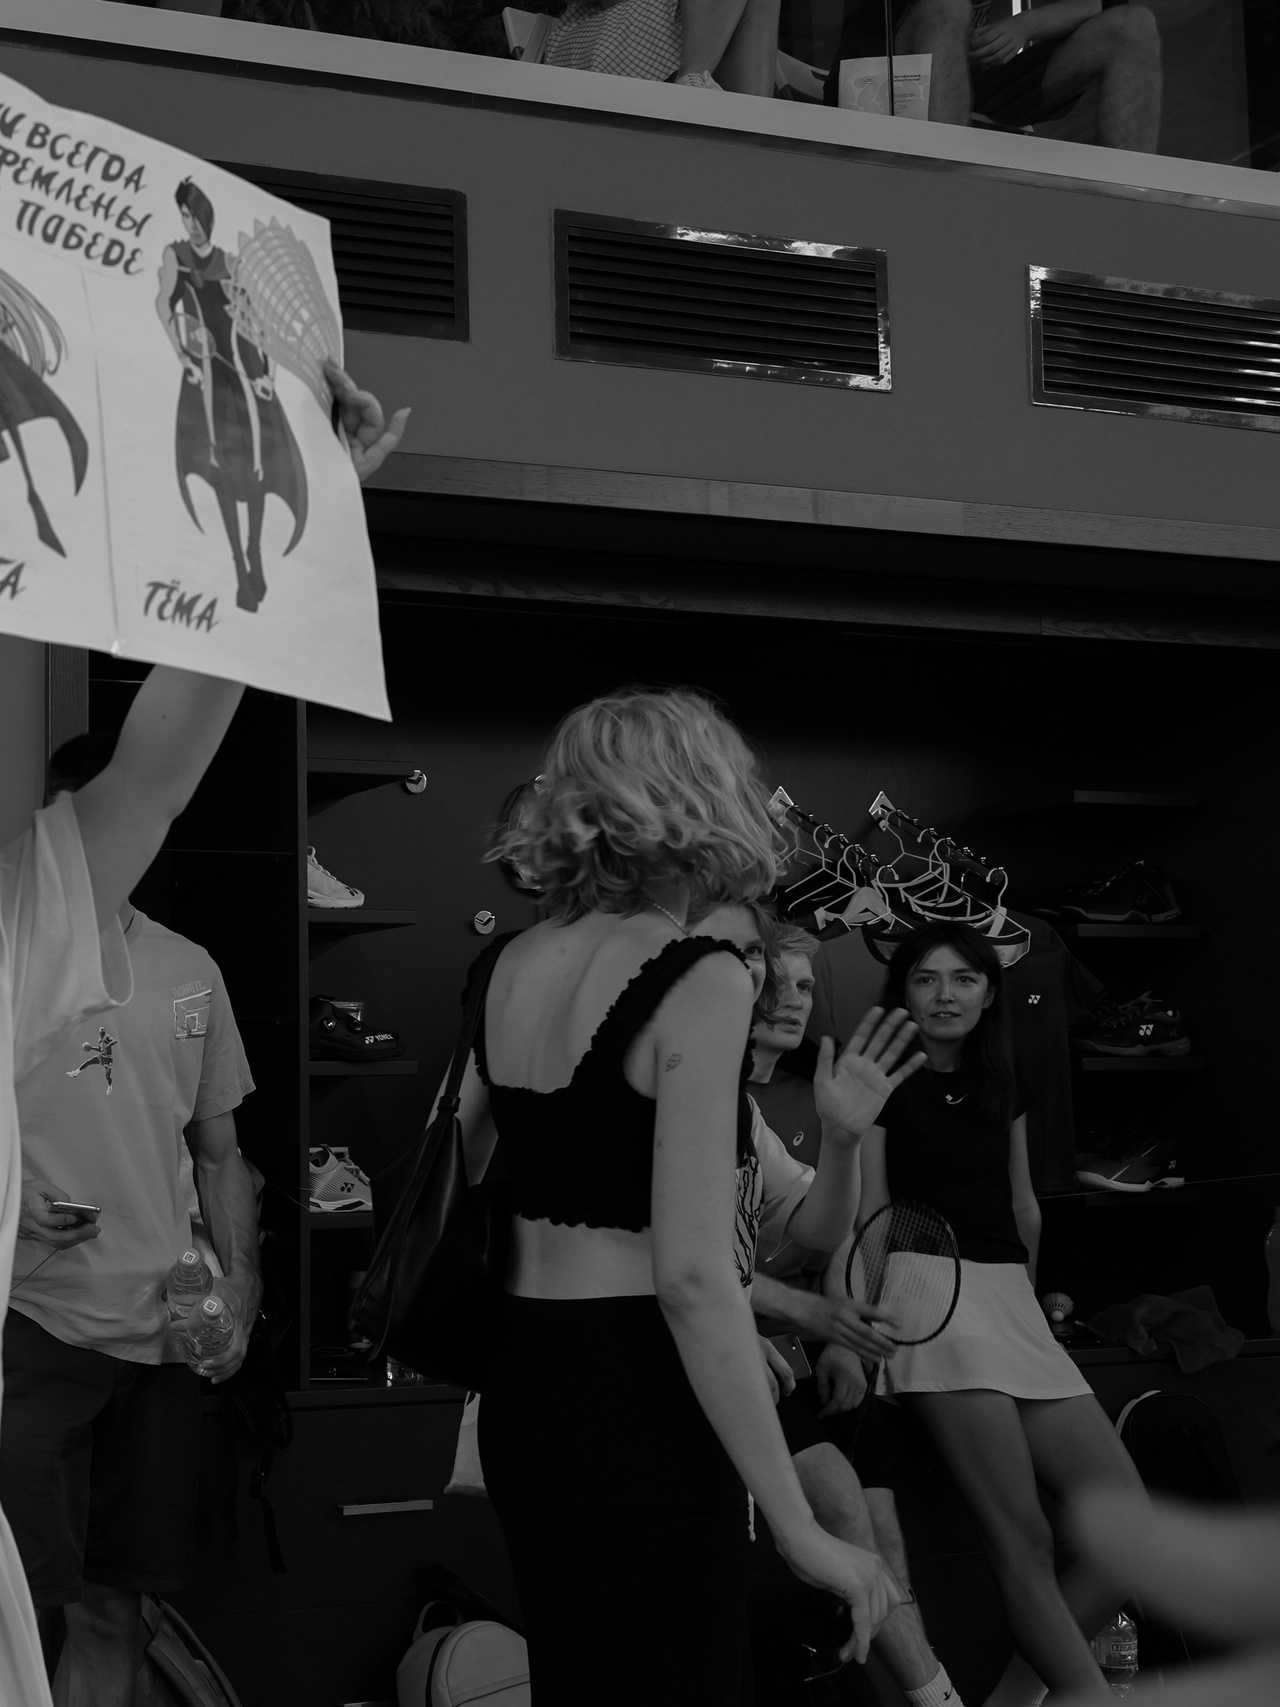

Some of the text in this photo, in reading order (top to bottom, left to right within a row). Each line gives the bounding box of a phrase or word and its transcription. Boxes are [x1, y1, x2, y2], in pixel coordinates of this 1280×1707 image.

[26, 122, 147, 194] ВСЕГДА
[16, 199, 144, 275] ПОБЕДЕ
[143, 580, 219, 633] ТЁМА
